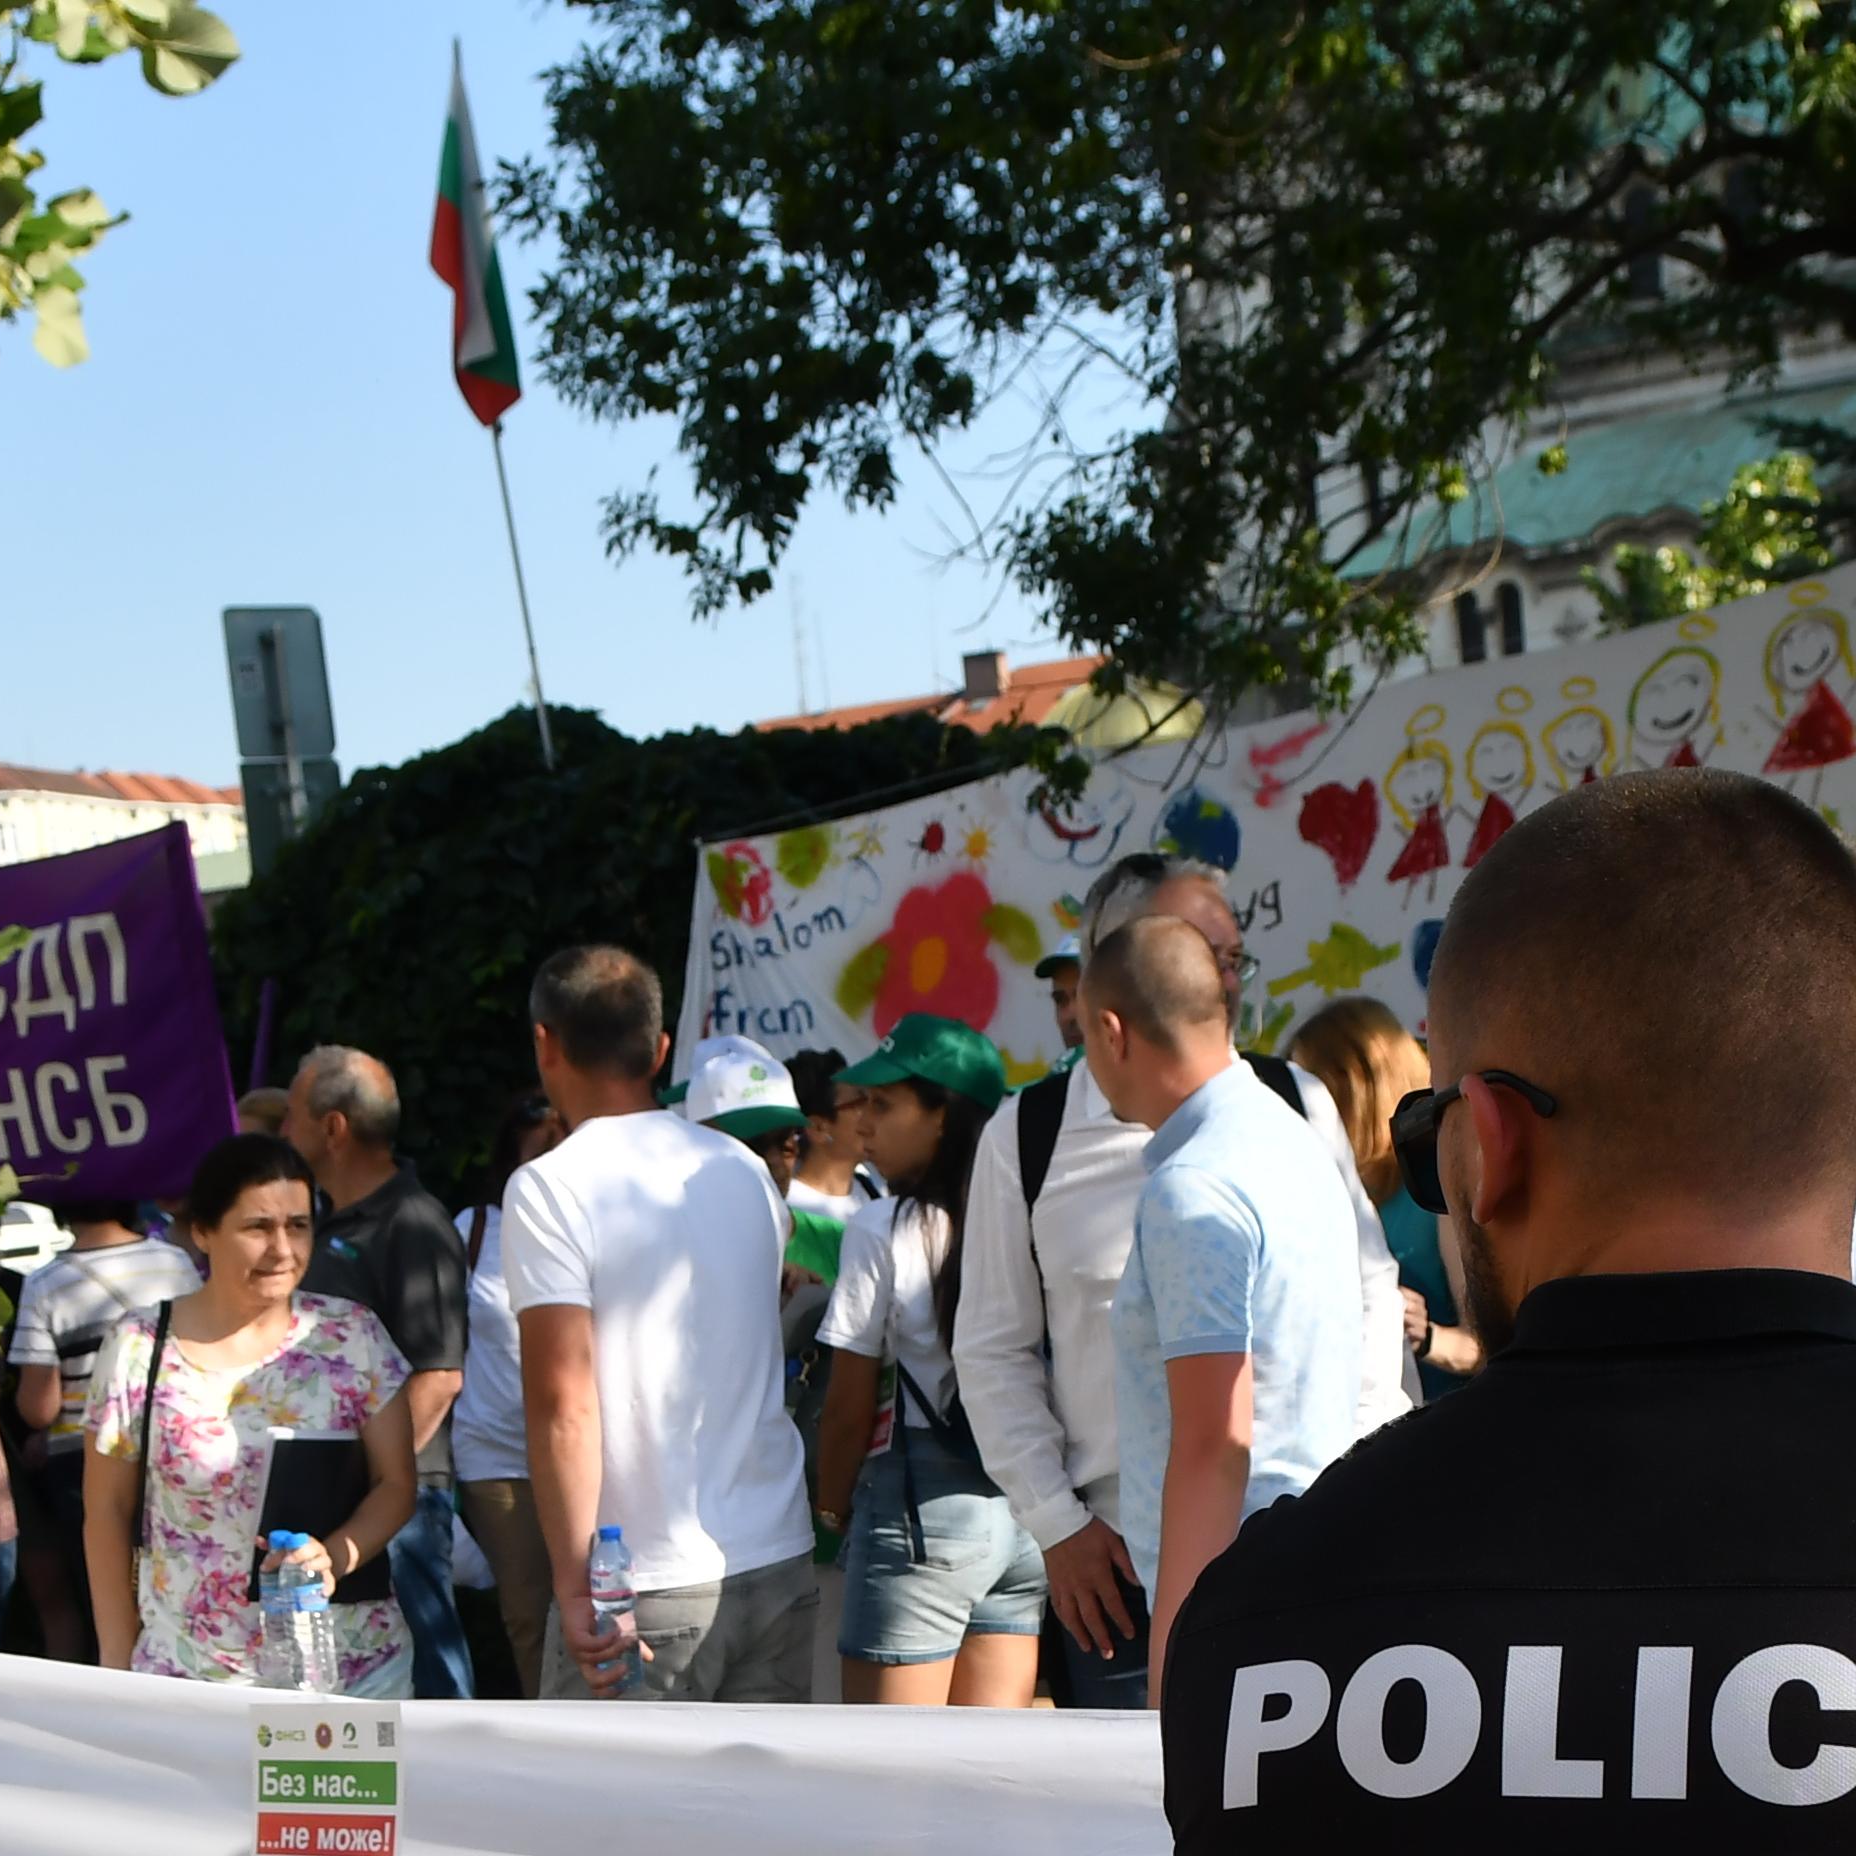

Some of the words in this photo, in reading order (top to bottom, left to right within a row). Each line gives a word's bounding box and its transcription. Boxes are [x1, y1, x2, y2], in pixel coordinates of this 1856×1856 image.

[262, 1766, 305, 1796] Без
[313, 1774, 378, 1798] нас...
[317, 1822, 391, 1852] може!
